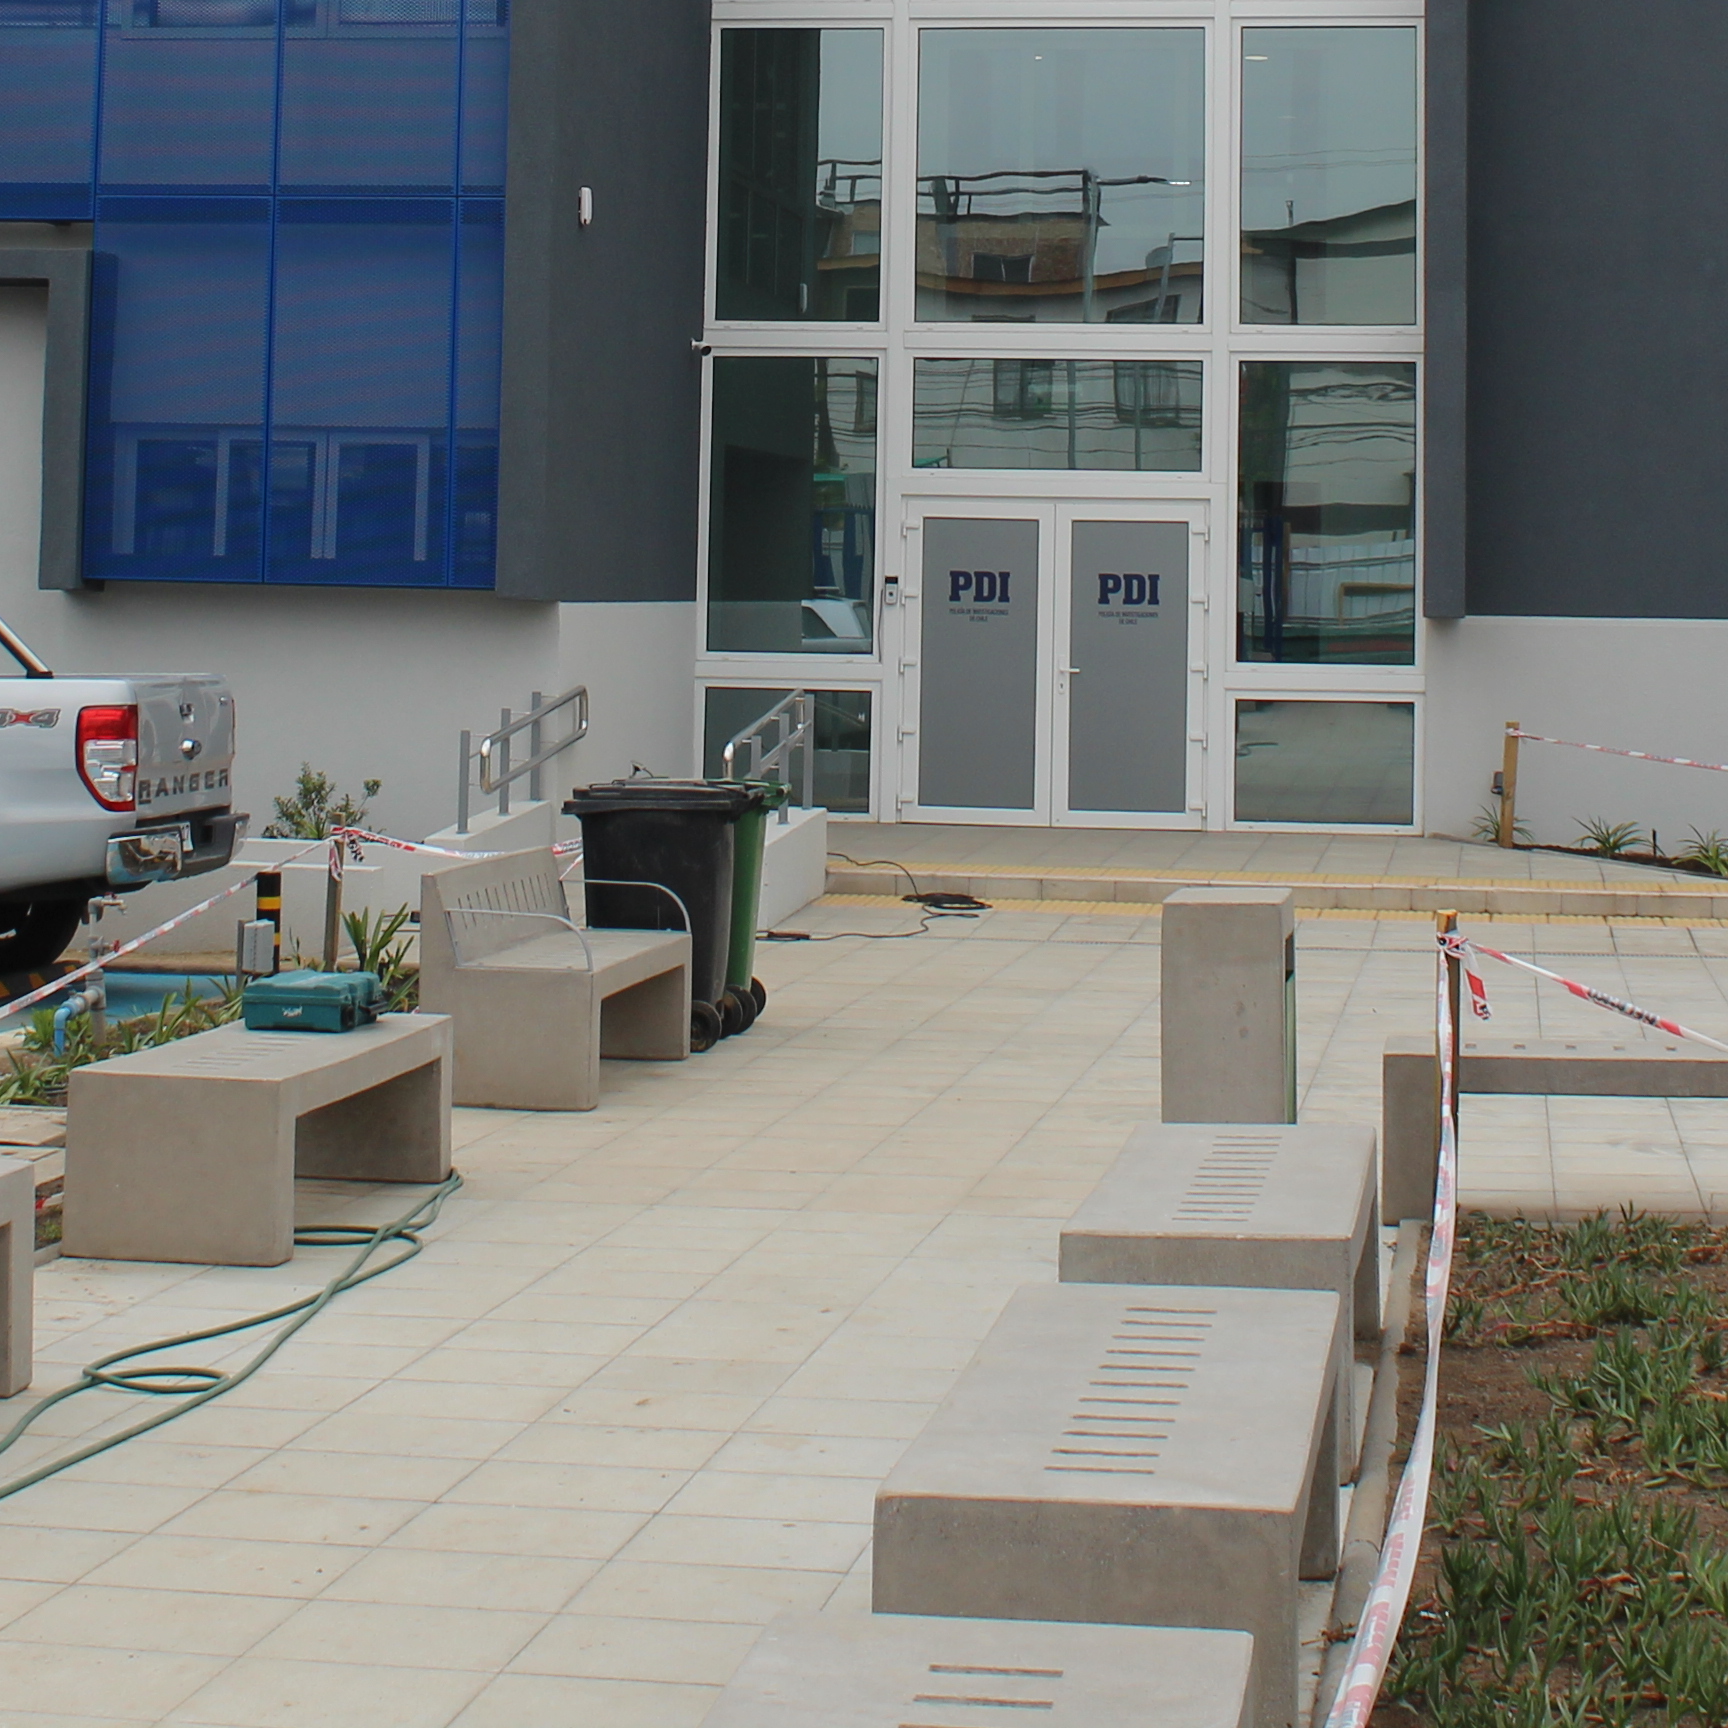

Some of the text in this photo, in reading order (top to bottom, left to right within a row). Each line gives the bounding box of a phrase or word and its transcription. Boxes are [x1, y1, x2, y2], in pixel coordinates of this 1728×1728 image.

[949, 570, 1011, 603] PDI
[1097, 573, 1160, 605] PDI
[138, 768, 230, 805] RANGER
